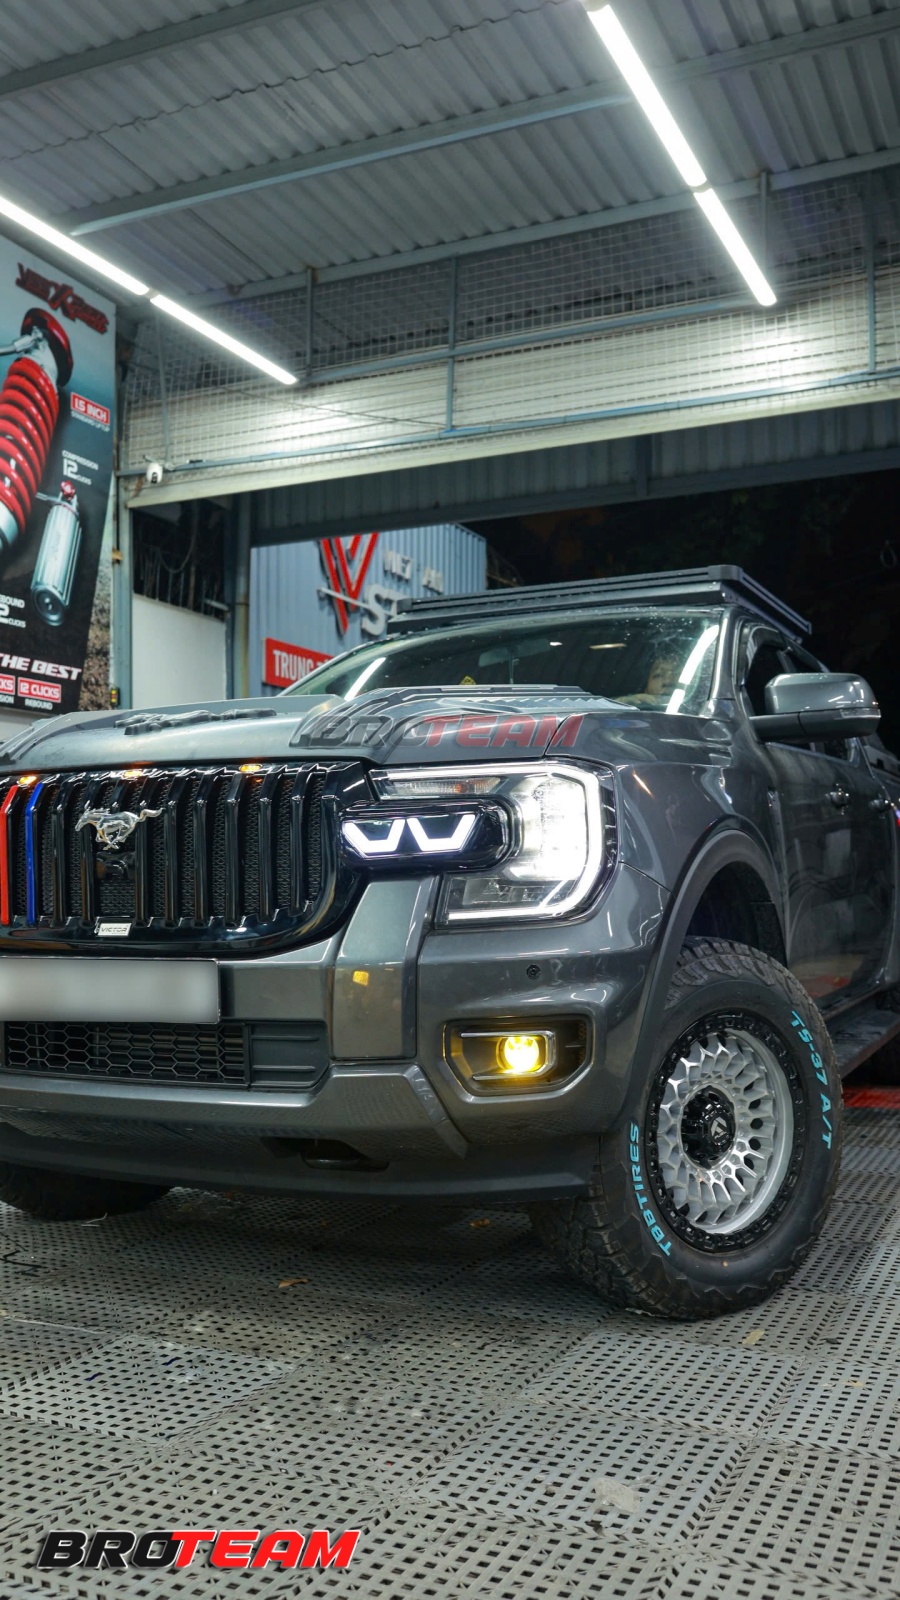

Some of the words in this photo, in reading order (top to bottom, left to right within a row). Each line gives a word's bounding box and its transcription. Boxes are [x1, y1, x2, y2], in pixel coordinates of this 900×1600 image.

[87, 405, 107, 422] INCH
[62, 450, 99, 470] COMPRESSION
[63, 459, 78, 480] 12
[0, 594, 25, 608] EBOUND
[31, 660, 82, 680] BEST
[20, 682, 30, 693] 12
[31, 684, 60, 699] CLICKS
[25, 698, 53, 710] REBOUND
[790, 1010, 828, 1086] TS-37
[820, 1093, 832, 1149] A/T
[629, 1123, 672, 1256] TBBTIRES
